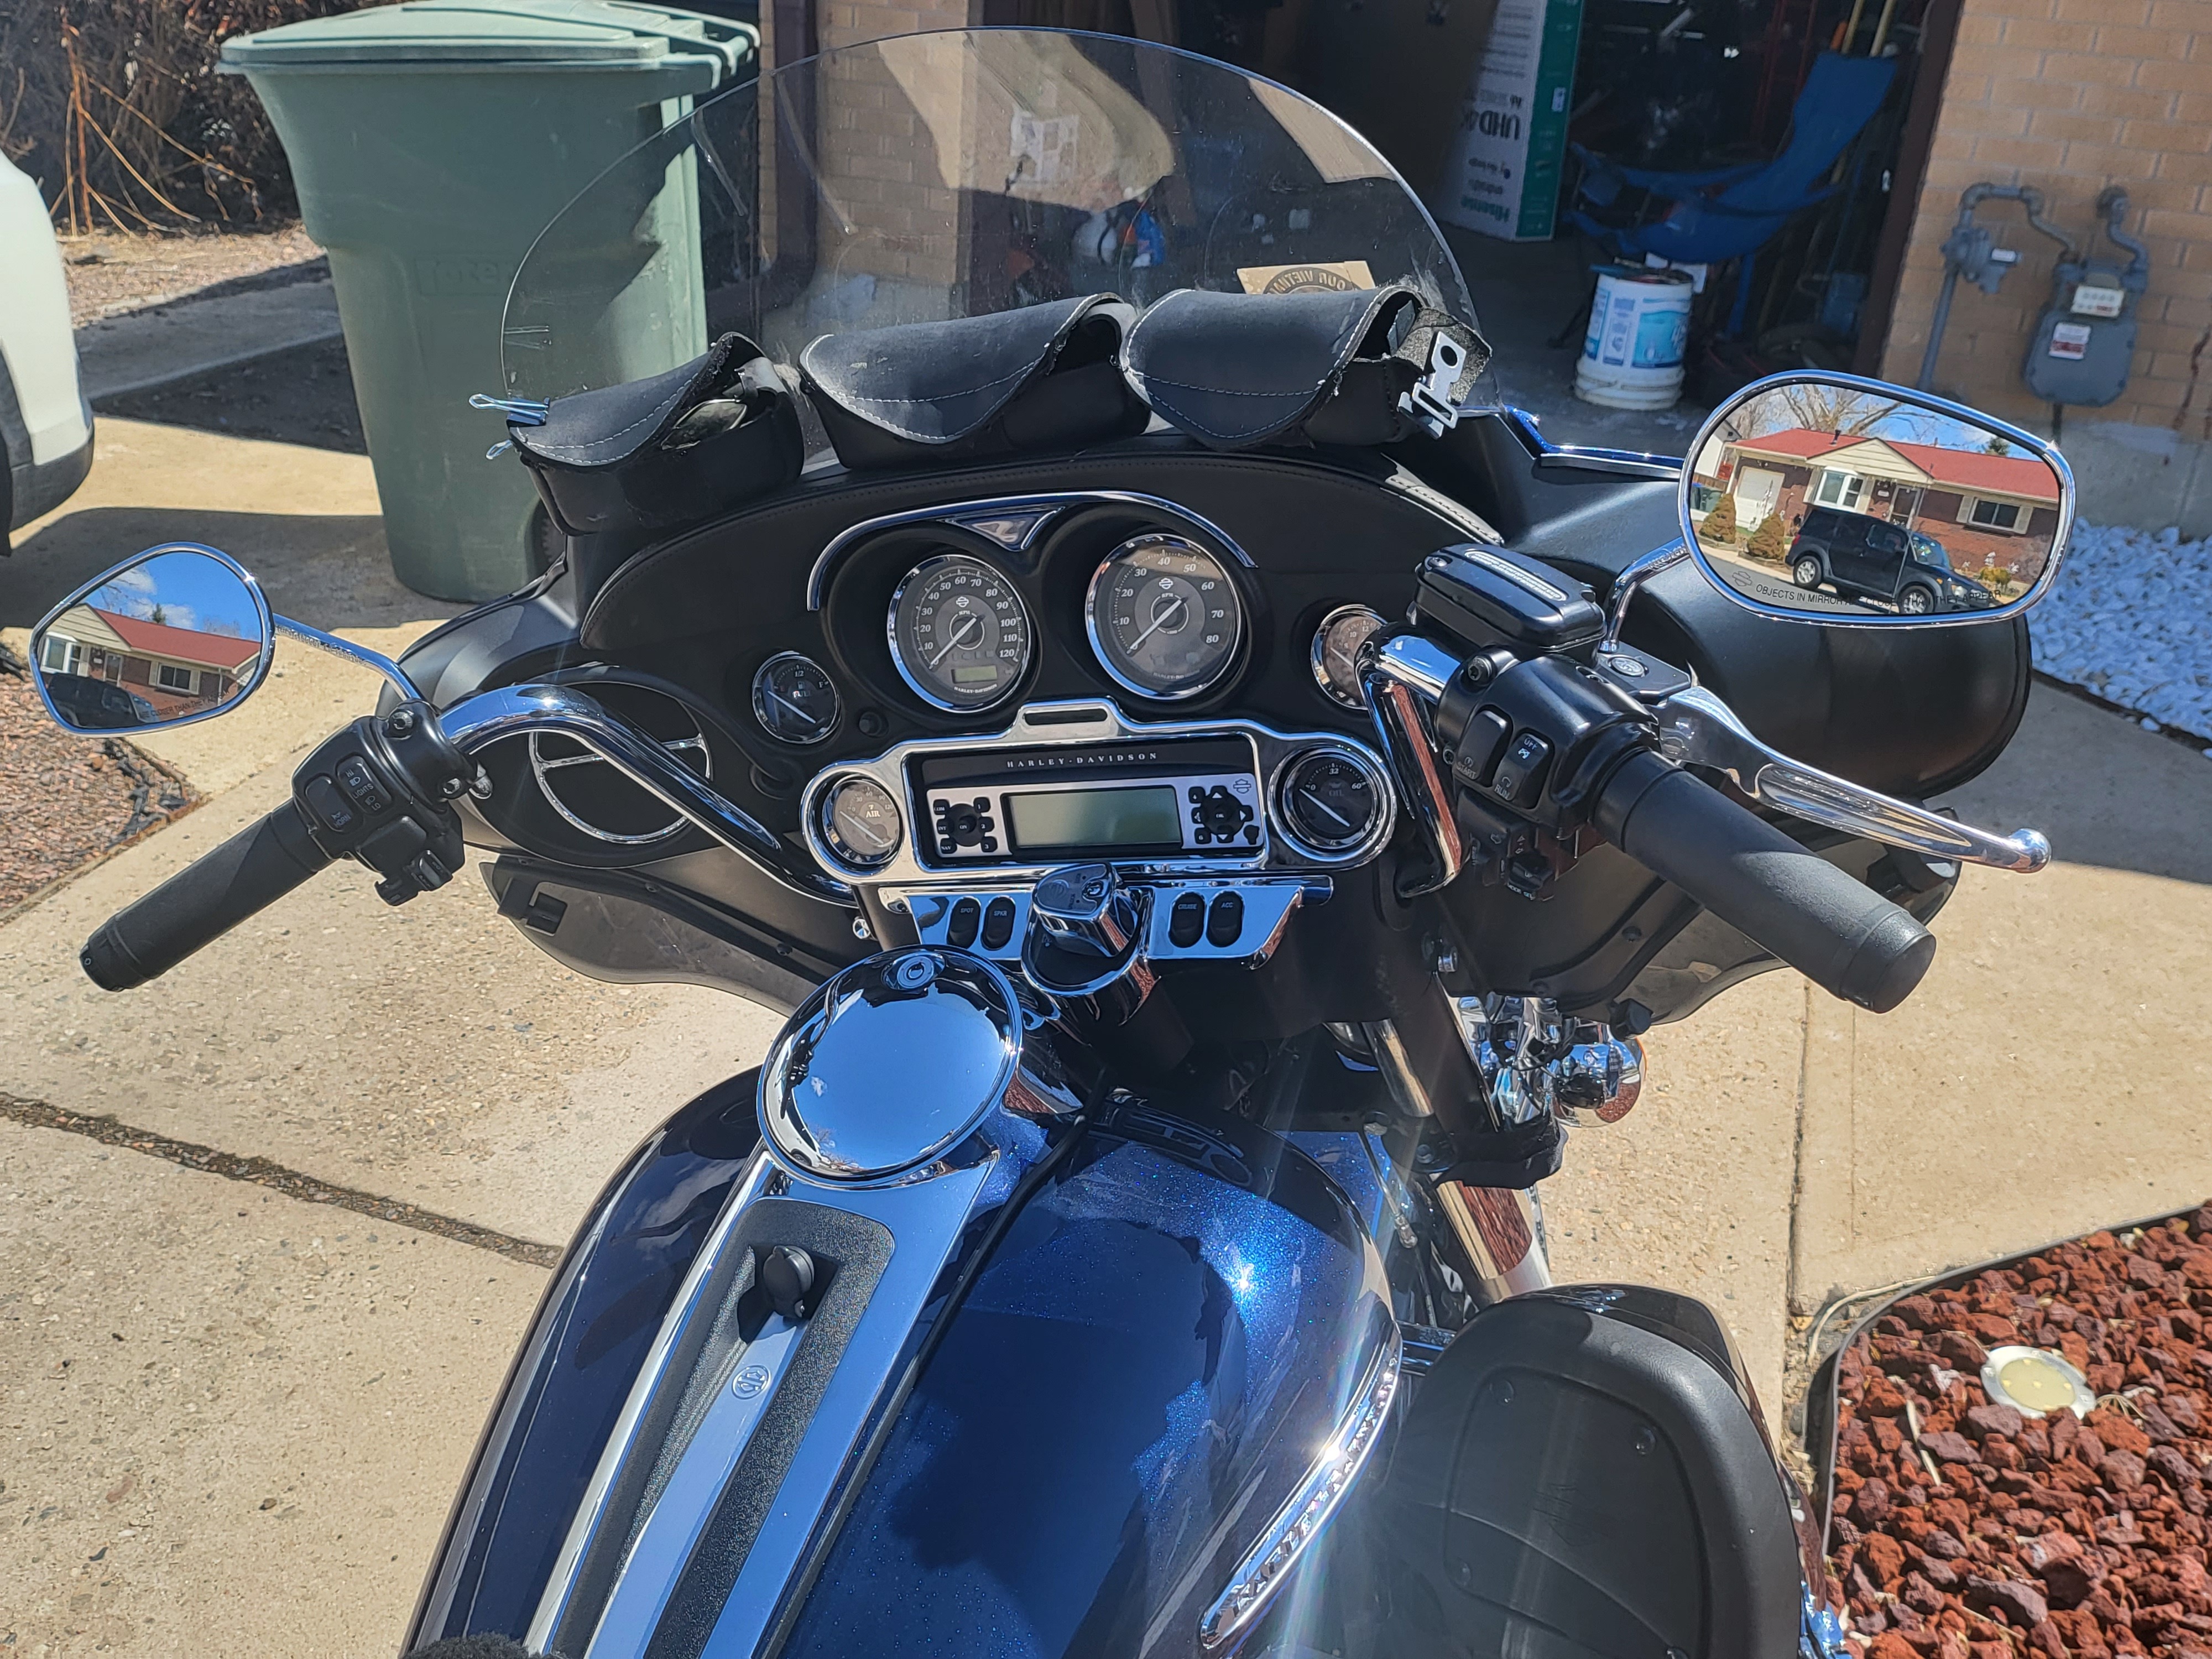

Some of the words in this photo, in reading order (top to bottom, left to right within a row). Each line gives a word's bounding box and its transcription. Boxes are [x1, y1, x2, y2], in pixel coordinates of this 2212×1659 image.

[1157, 556, 1170, 566] 40
[1134, 567, 1147, 577] 30
[1183, 563, 1196, 573] 50
[954, 576, 966, 585] 60
[970, 578, 982, 587] 70
[940, 582, 951, 591] 50
[1201, 581, 1214, 590] 60
[928, 592, 940, 601] 40
[985, 588, 998, 597] 80
[1121, 588, 1133, 597] 20
[1756, 584, 1794, 601] OBJECTS
[1797, 593, 1806, 602] IN
[1808, 594, 1844, 606] MIRROR
[1865, 597, 1904, 607] CLOSE
[1907, 596, 1931, 607] THA
[1963, 589, 2001, 603] APPEAR
[997, 601, 1009, 610] 90
[921, 607, 932, 615] 30
[1211, 609, 1224, 618] 70
[1000, 618, 1016, 627] 100
[1119, 617, 1130, 625] 10
[920, 624, 931, 633] 20
[1003, 634, 1017, 643] 110
[1206, 634, 1219, 644] 80
[924, 641, 933, 650] 10
[999, 649, 1015, 658] 120
[1153, 669, 1199, 680] HARLEY-DAV
[954, 684, 998, 694] HARLEY-DAVIDSON
[1006, 753, 1157, 768] HARLEY-DAVIDSON
[345, 769, 354, 778] HI
[1456, 761, 1477, 780] START
[352, 783, 374, 799] LIGHTS
[1494, 784, 1510, 799] RUN
[371, 802, 381, 811] LO
[865, 810, 880, 818] AIR
[333, 813, 352, 828] HORN
